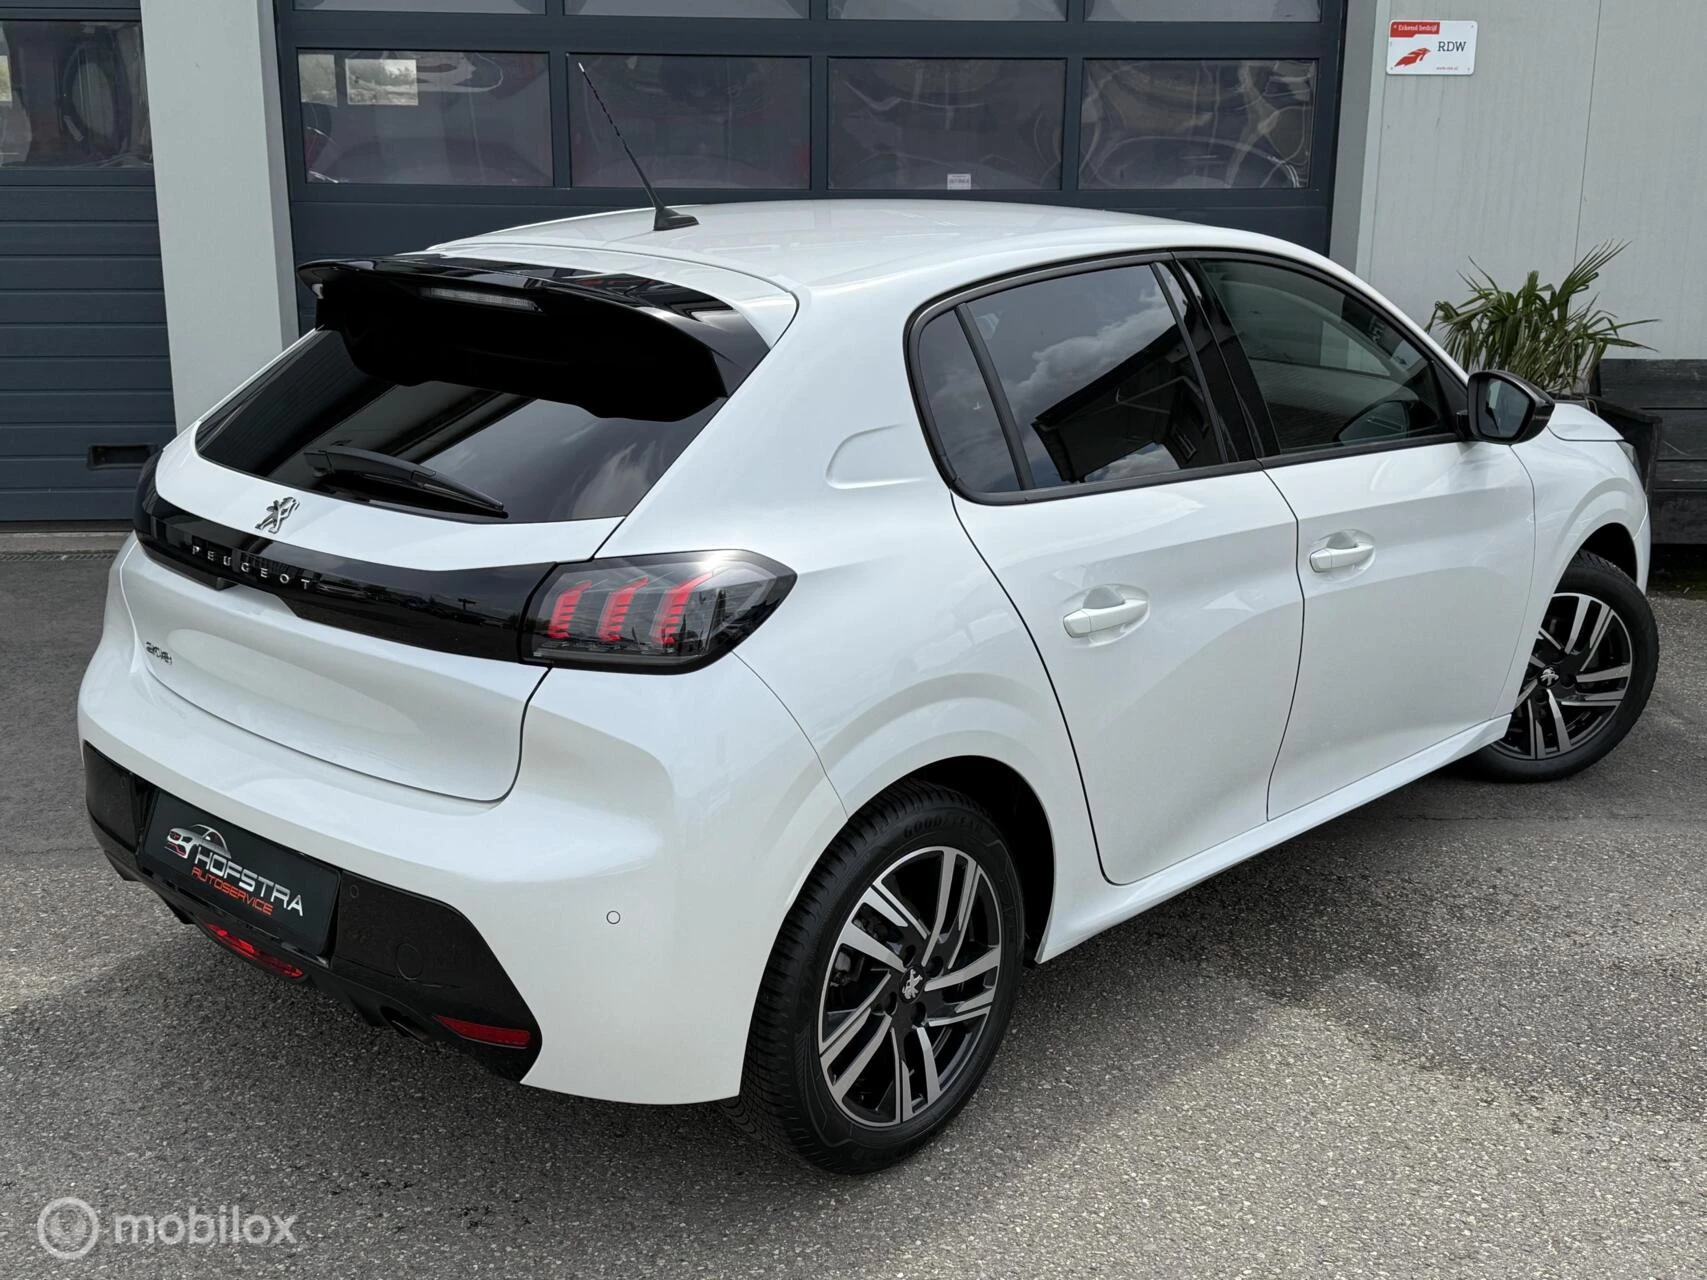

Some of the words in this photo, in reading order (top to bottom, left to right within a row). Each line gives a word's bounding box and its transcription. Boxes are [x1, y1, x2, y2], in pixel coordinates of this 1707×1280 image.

[1437, 41, 1466, 52] RDW
[192, 545, 310, 590] PEUGEOT
[191, 866, 274, 916] AUTOSERVICE
[195, 846, 303, 917] HOFSTRA
